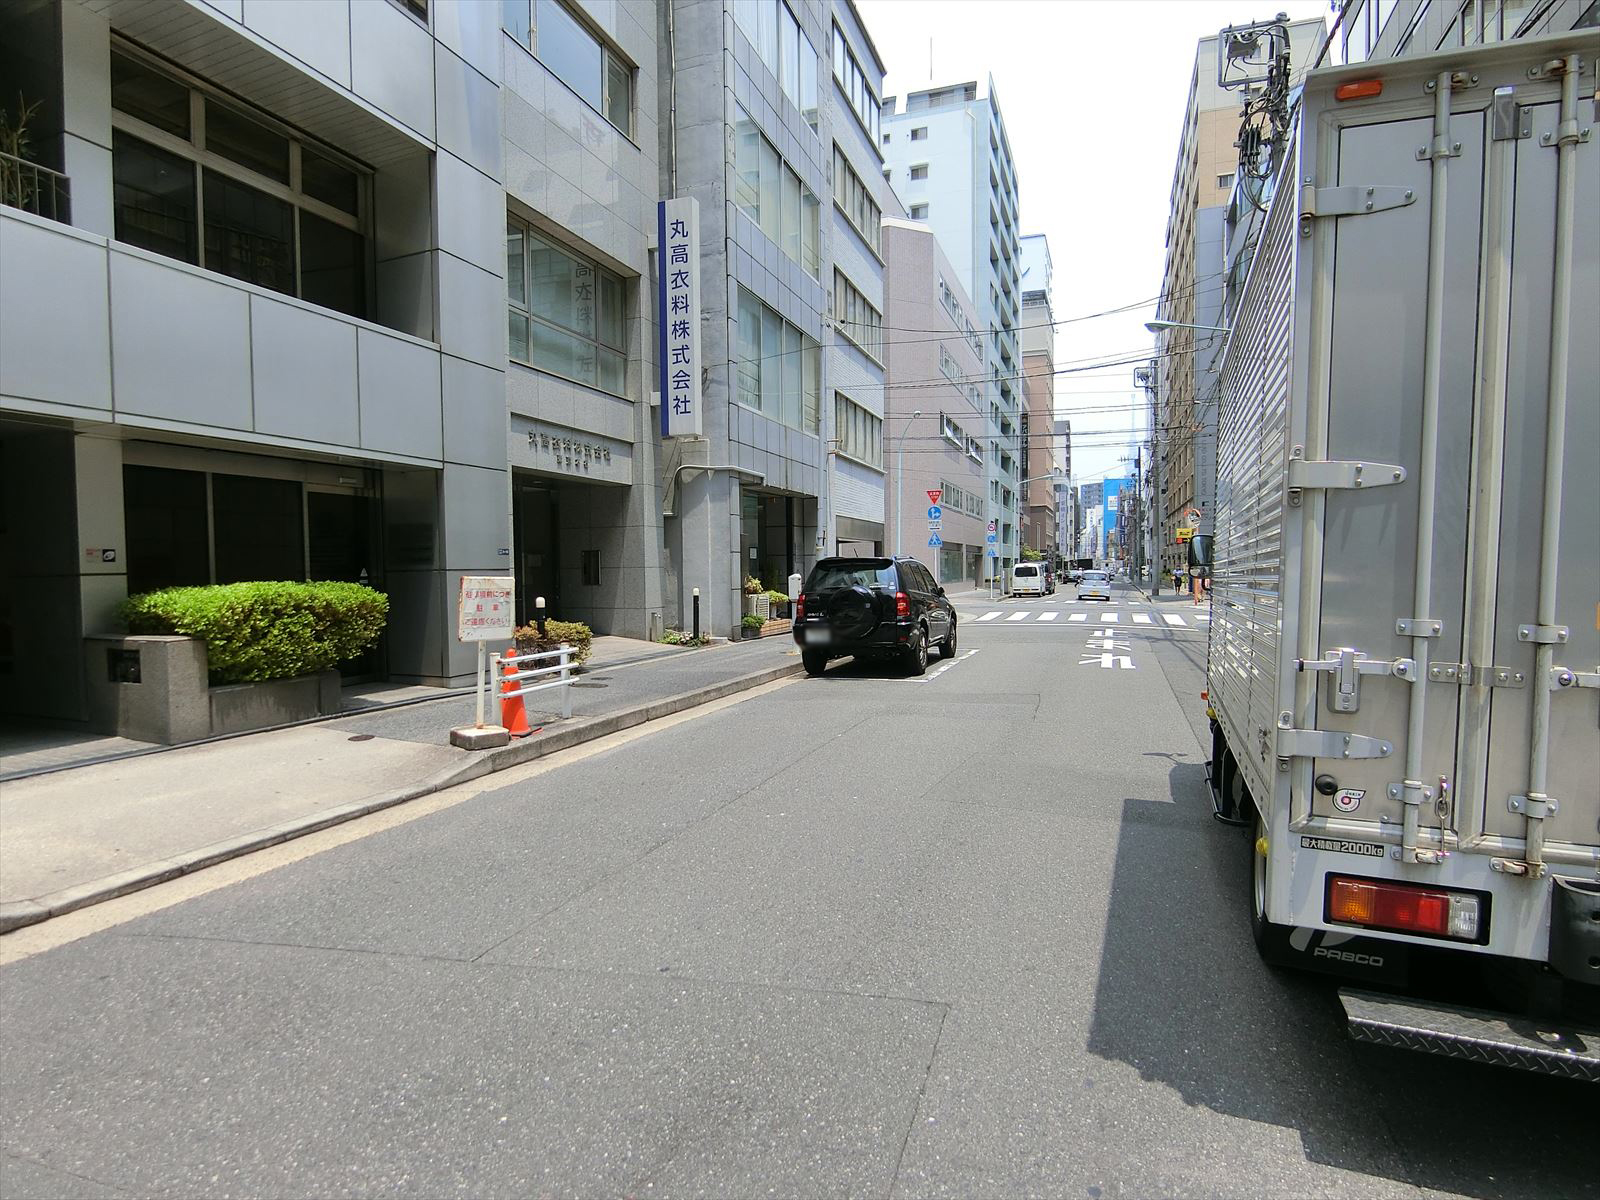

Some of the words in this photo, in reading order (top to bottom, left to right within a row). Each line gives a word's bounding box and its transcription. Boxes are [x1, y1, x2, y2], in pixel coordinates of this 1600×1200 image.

[670, 218, 692, 416] 丸高衣料株式会社
[1313, 947, 1384, 967] PABCO
